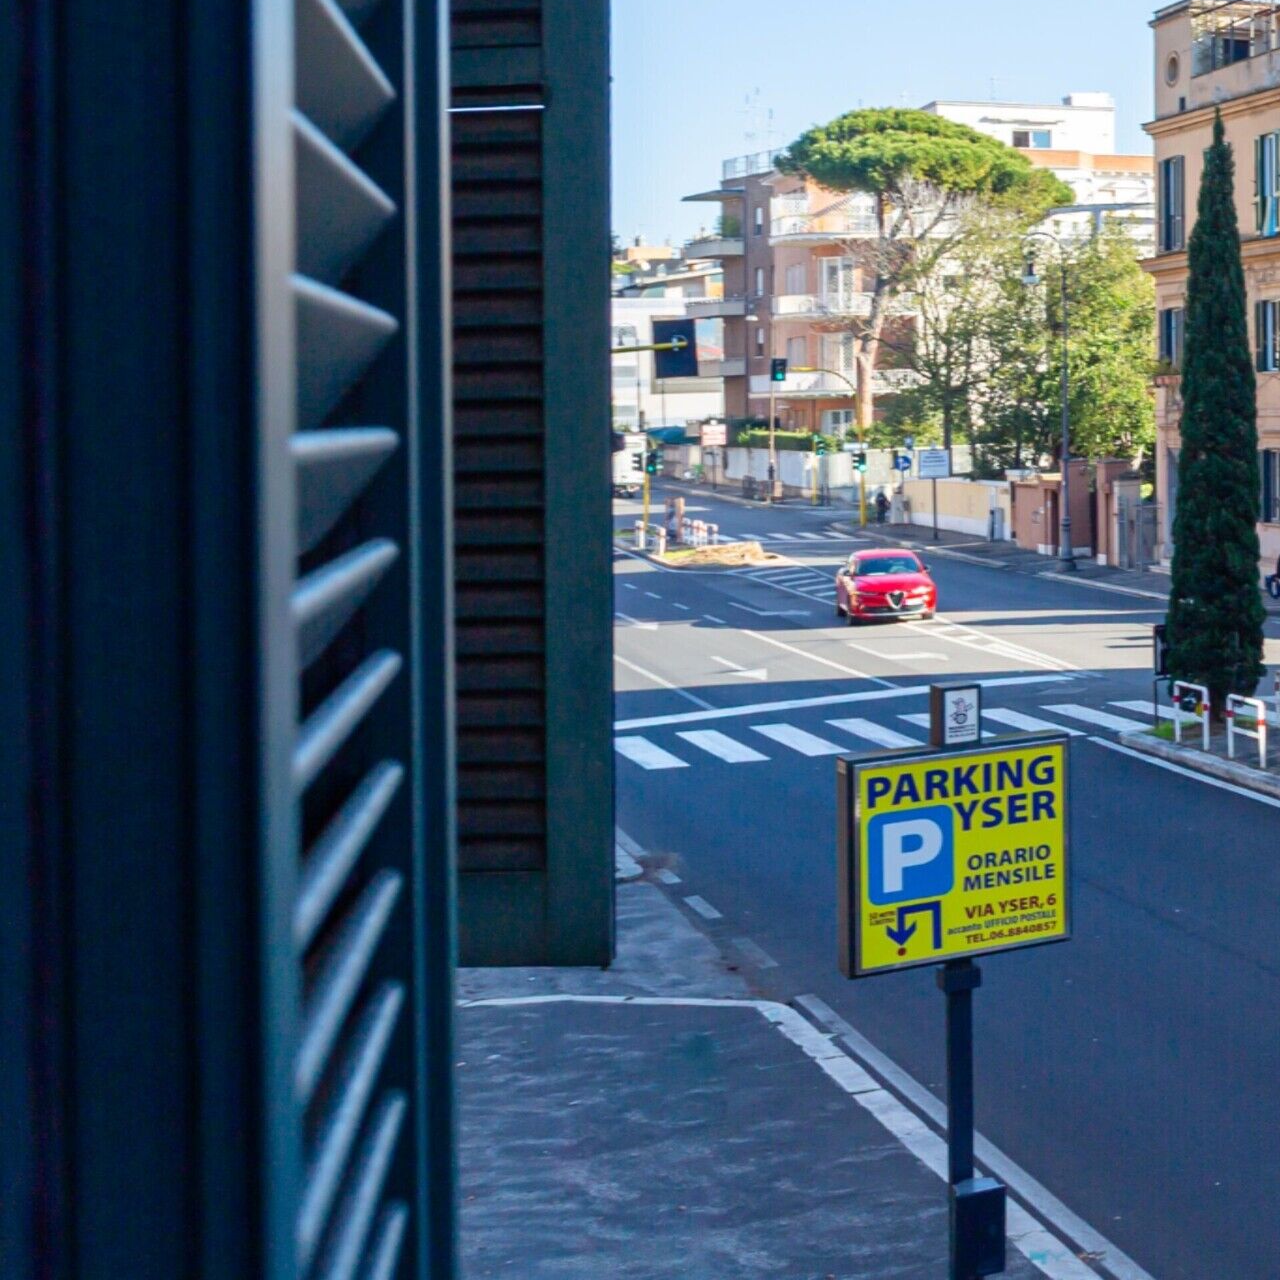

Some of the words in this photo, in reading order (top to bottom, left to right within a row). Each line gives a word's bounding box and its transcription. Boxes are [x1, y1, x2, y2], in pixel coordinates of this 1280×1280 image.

[867, 755, 1055, 809] PARKING
[954, 790, 1055, 831] YSER
[883, 818, 943, 894] P
[967, 844, 1051, 871] ORARIO
[963, 863, 1056, 892] MENSILE
[965, 903, 995, 919] VIA
[999, 896, 1044, 913] YSER,
[1047, 893, 1057, 906] 6
[984, 916, 1018, 928] UFFICIO
[1020, 909, 1056, 922] POSTALE
